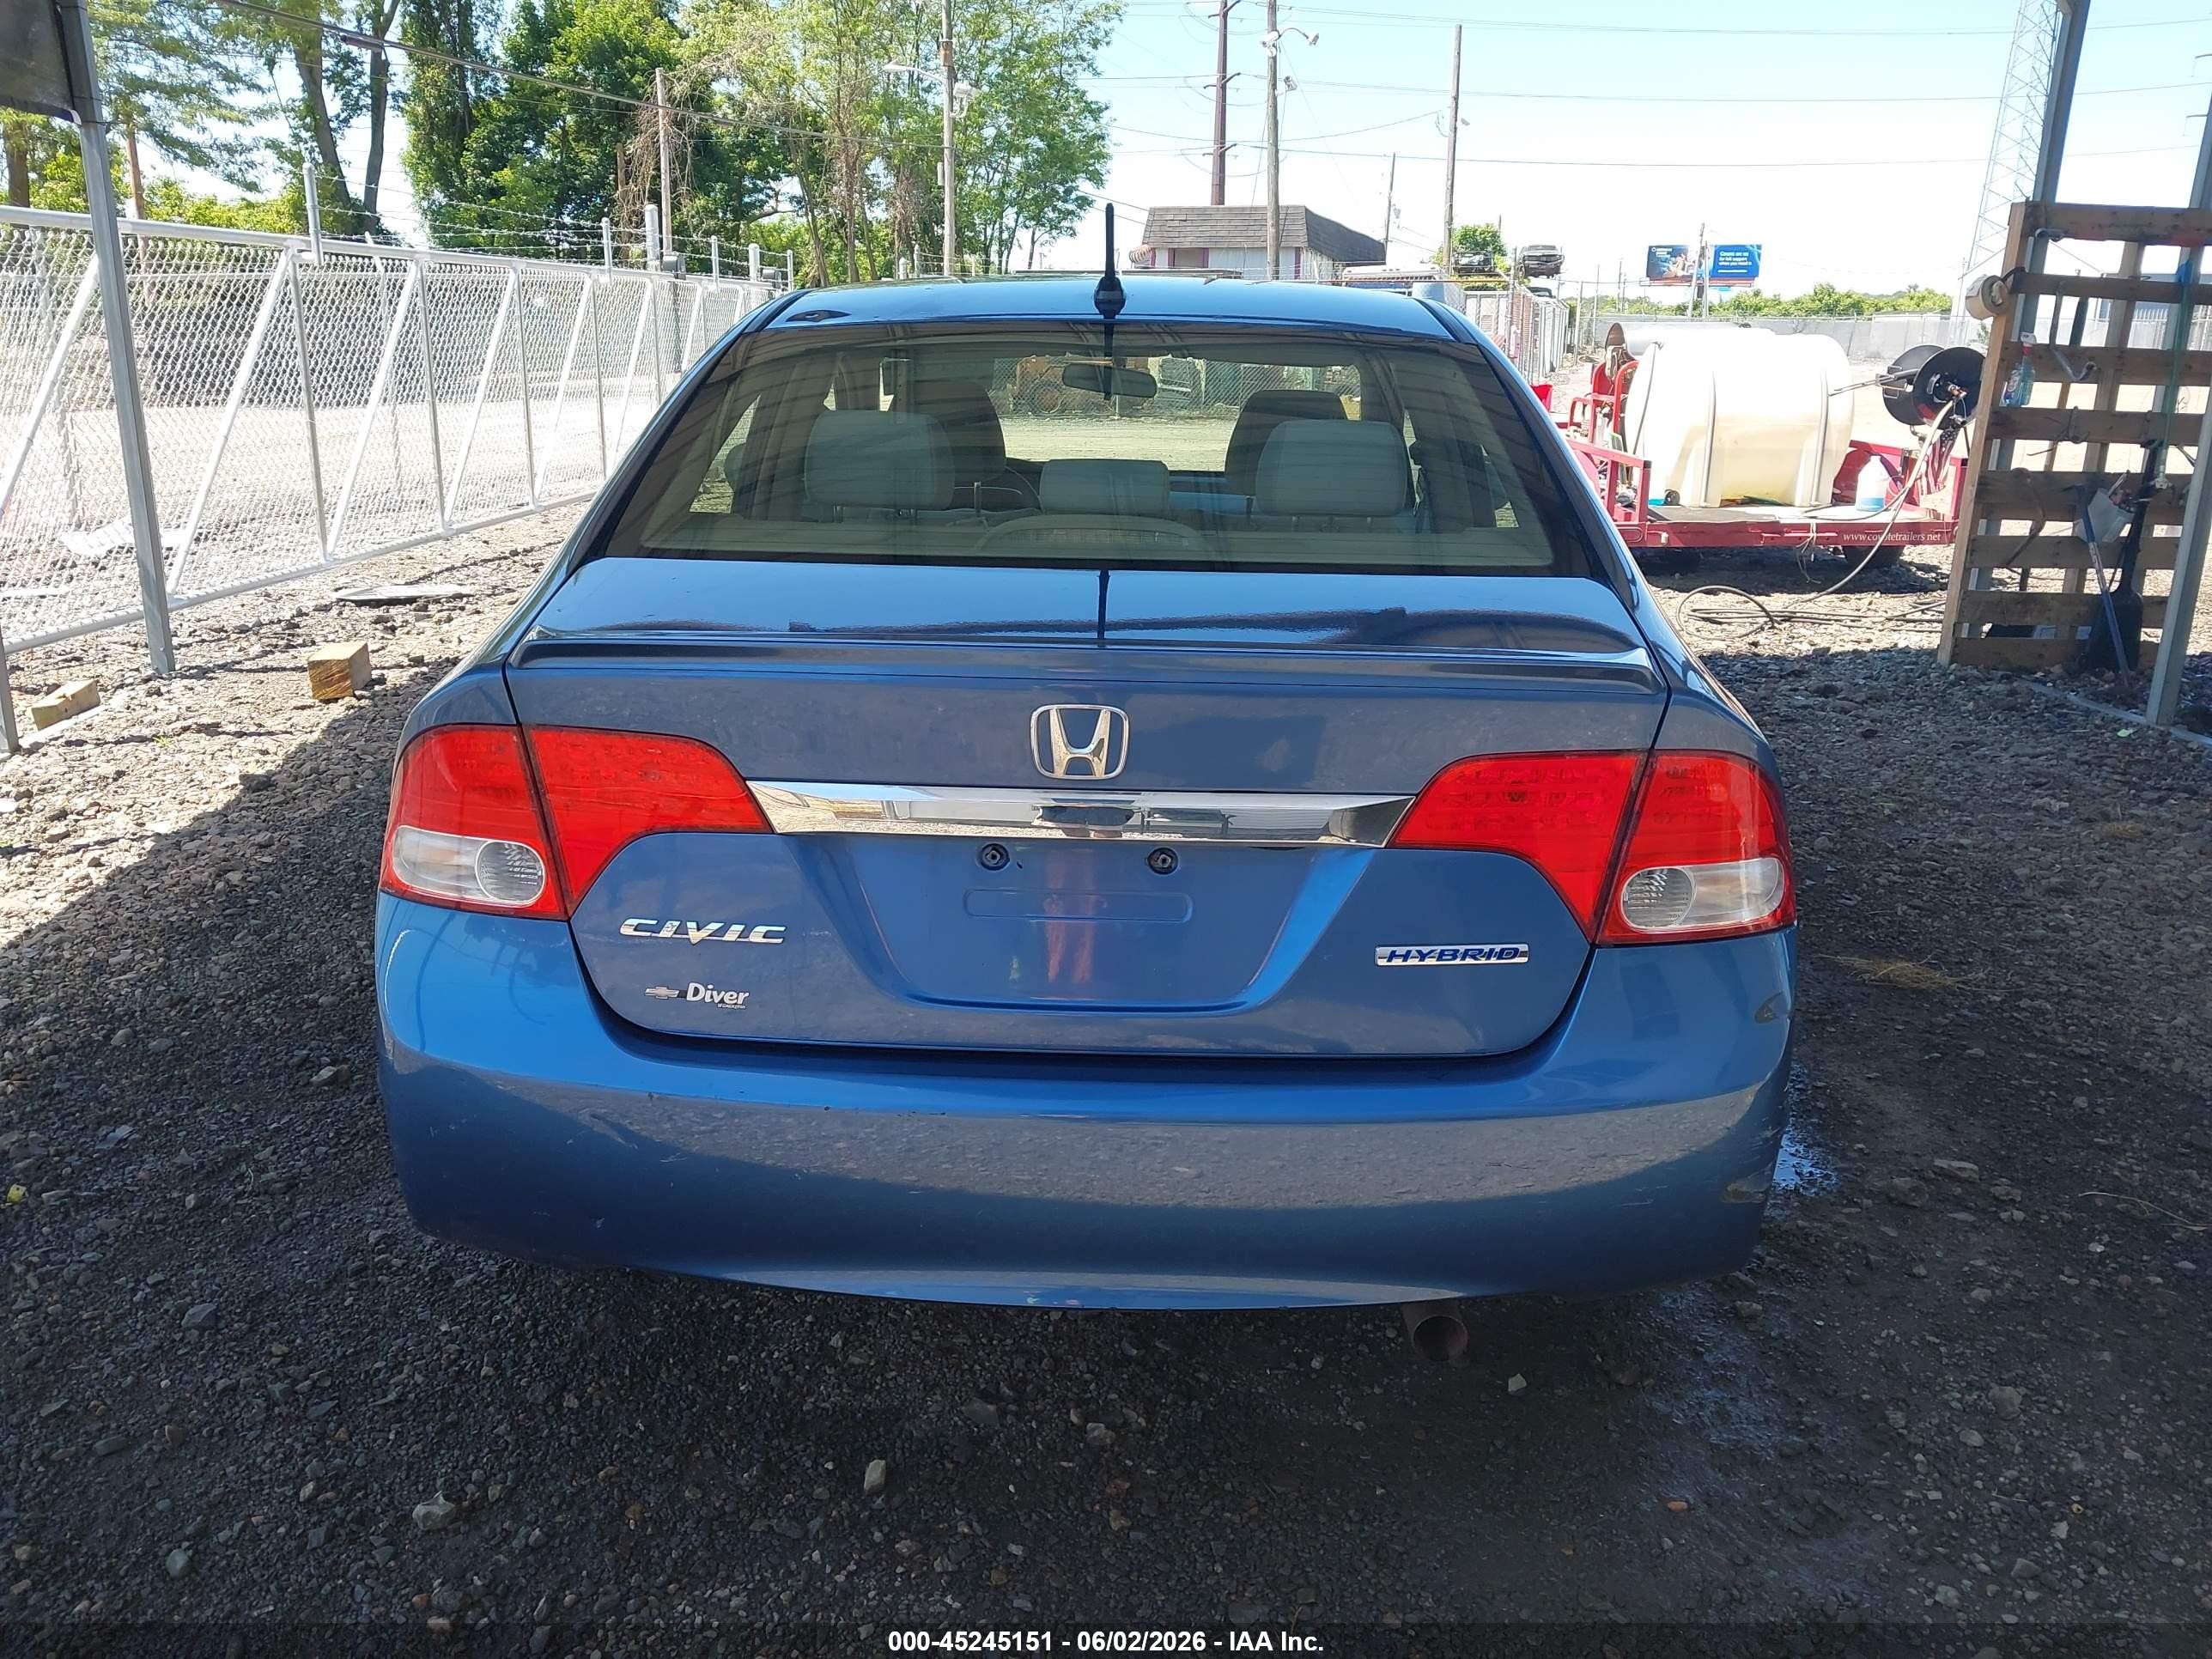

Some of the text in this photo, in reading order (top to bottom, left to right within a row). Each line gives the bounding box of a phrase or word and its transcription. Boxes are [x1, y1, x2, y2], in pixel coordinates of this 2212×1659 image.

[619, 918, 787, 945] CIVIC
[1386, 947, 1520, 963] HYBRID
[685, 981, 750, 1006] Diver
